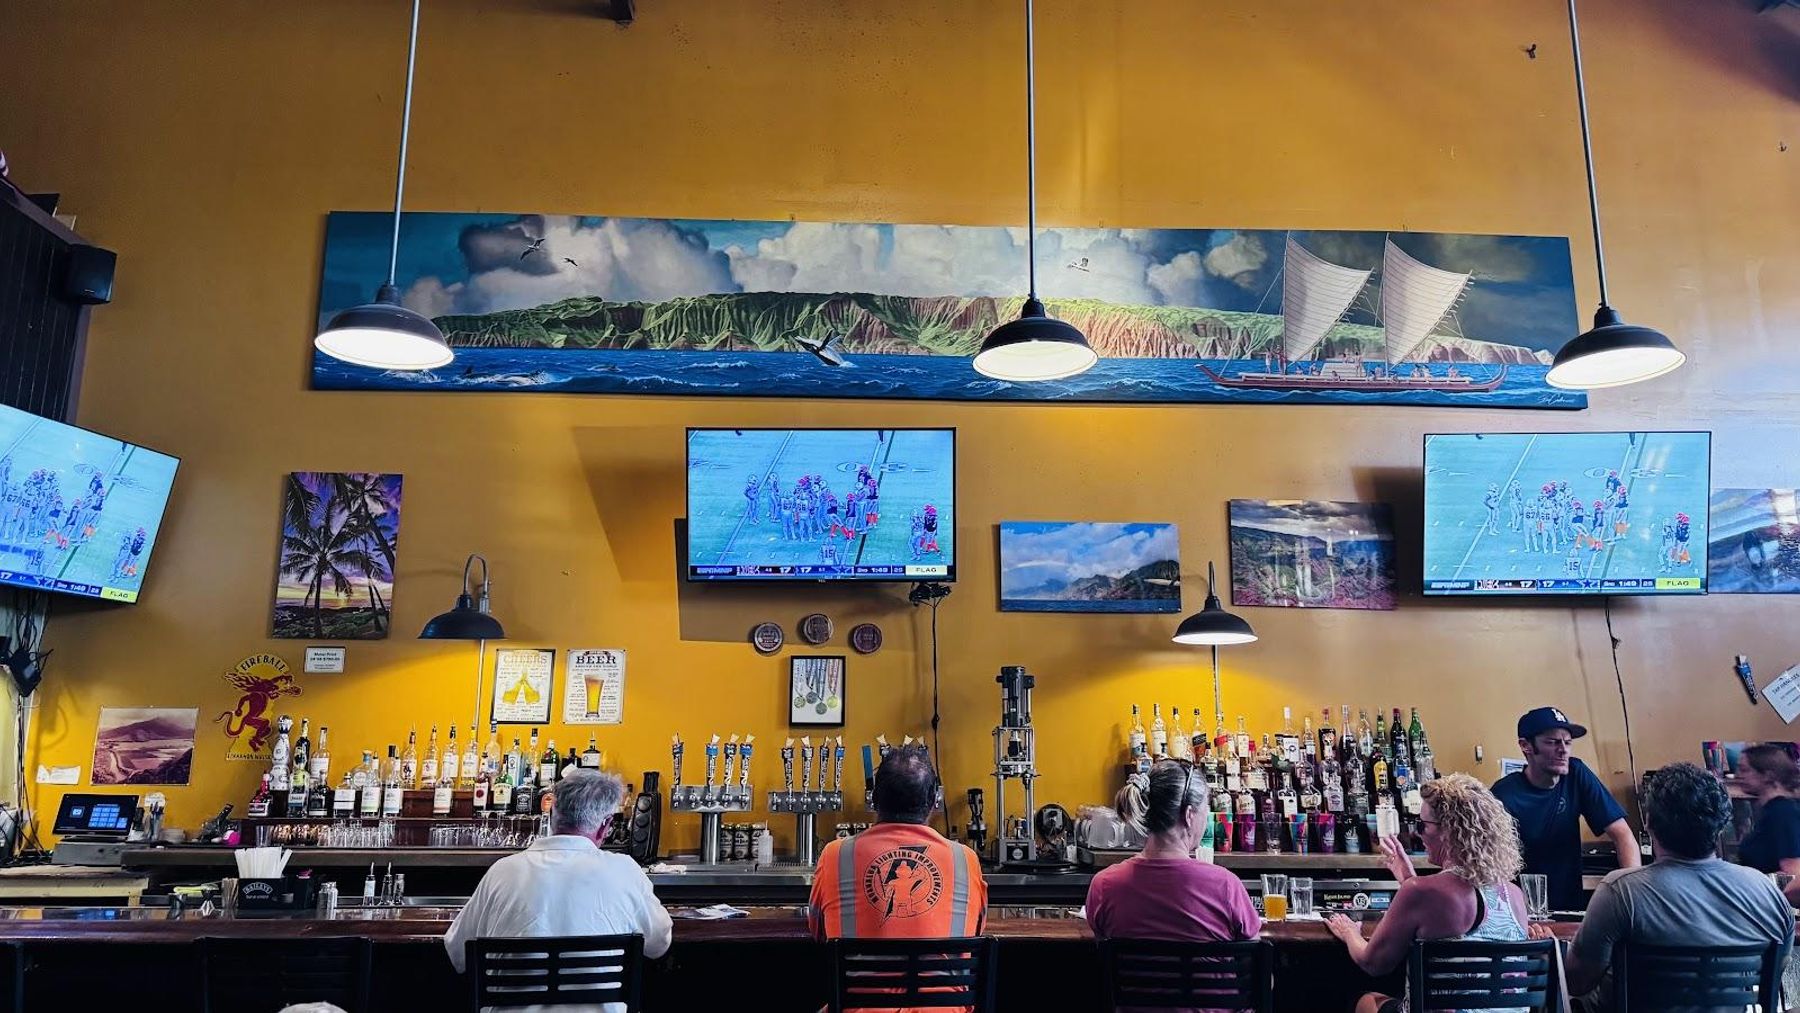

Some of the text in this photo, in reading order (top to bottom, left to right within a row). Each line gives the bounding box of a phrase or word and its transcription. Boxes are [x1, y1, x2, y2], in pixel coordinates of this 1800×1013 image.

[109, 590, 129, 599] FLAG
[240, 655, 285, 671] FIREBALL
[575, 655, 617, 665] BEER
[1551, 708, 1566, 722] LA
[875, 851, 912, 865] LIGHTING
[915, 853, 942, 906] IMPROVEMENTS
